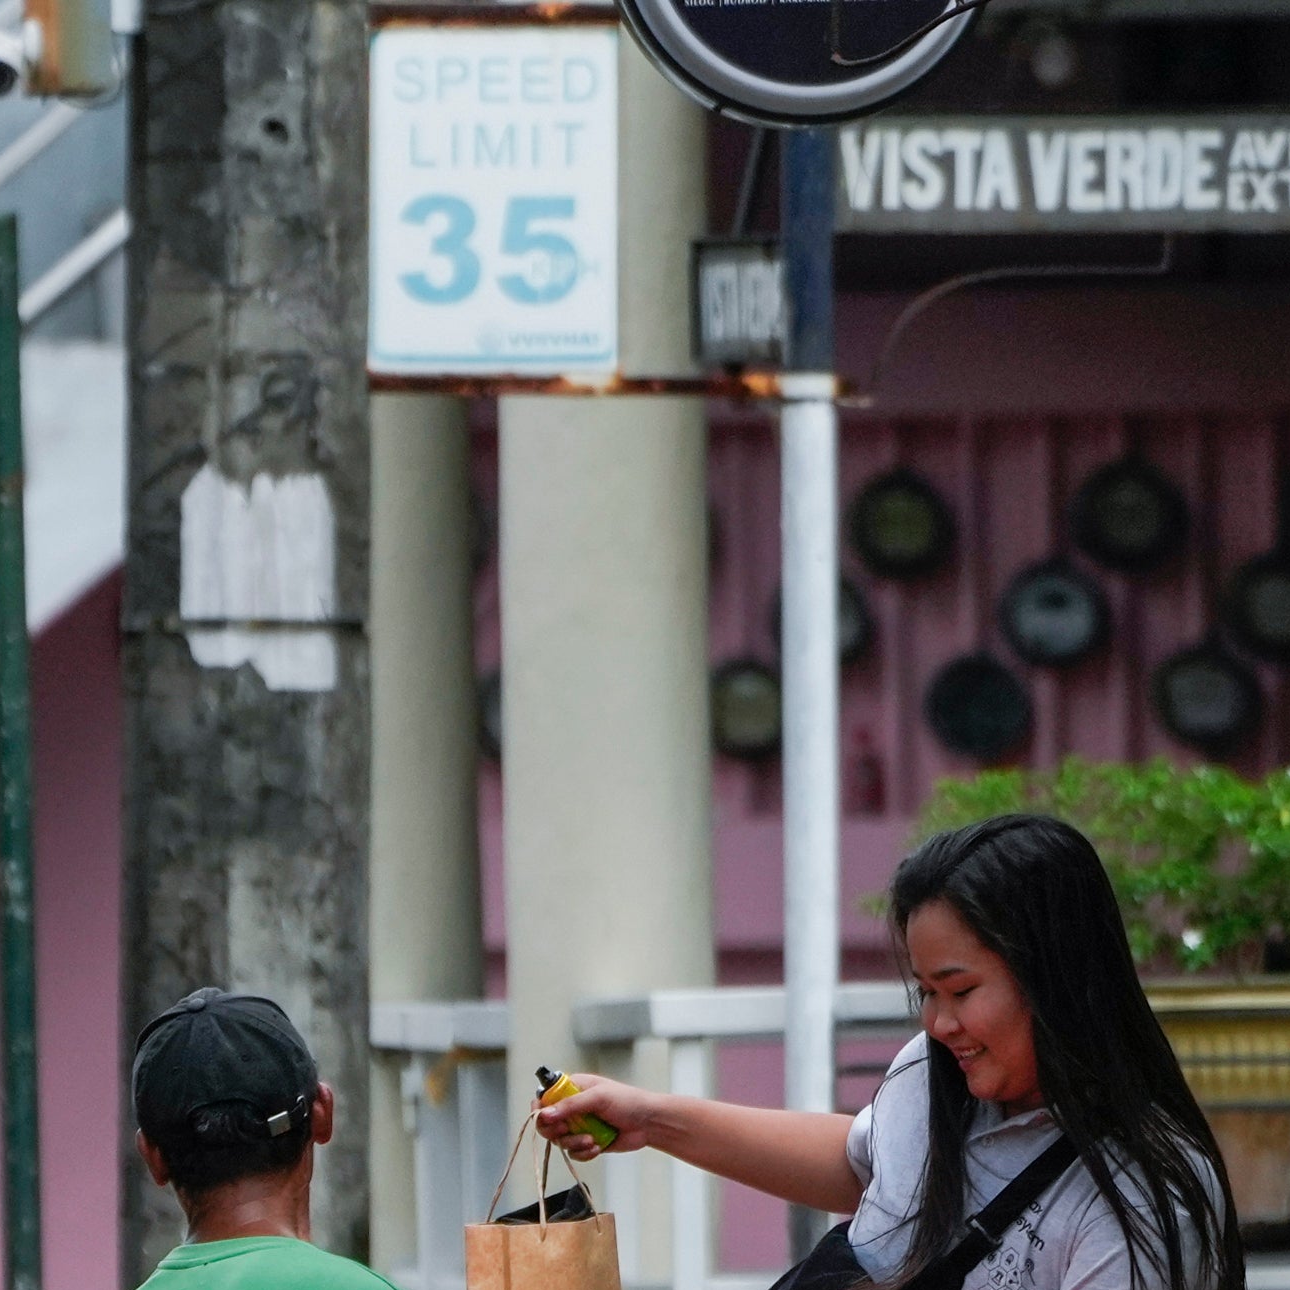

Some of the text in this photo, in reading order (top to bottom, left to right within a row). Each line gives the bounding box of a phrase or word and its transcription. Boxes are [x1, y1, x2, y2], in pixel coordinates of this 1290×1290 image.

[392, 56, 601, 105] SPEED
[409, 122, 584, 168] LIMIT
[839, 126, 1021, 213] VISTA
[1026, 126, 1224, 213] VERDE
[397, 192, 581, 308] 35
